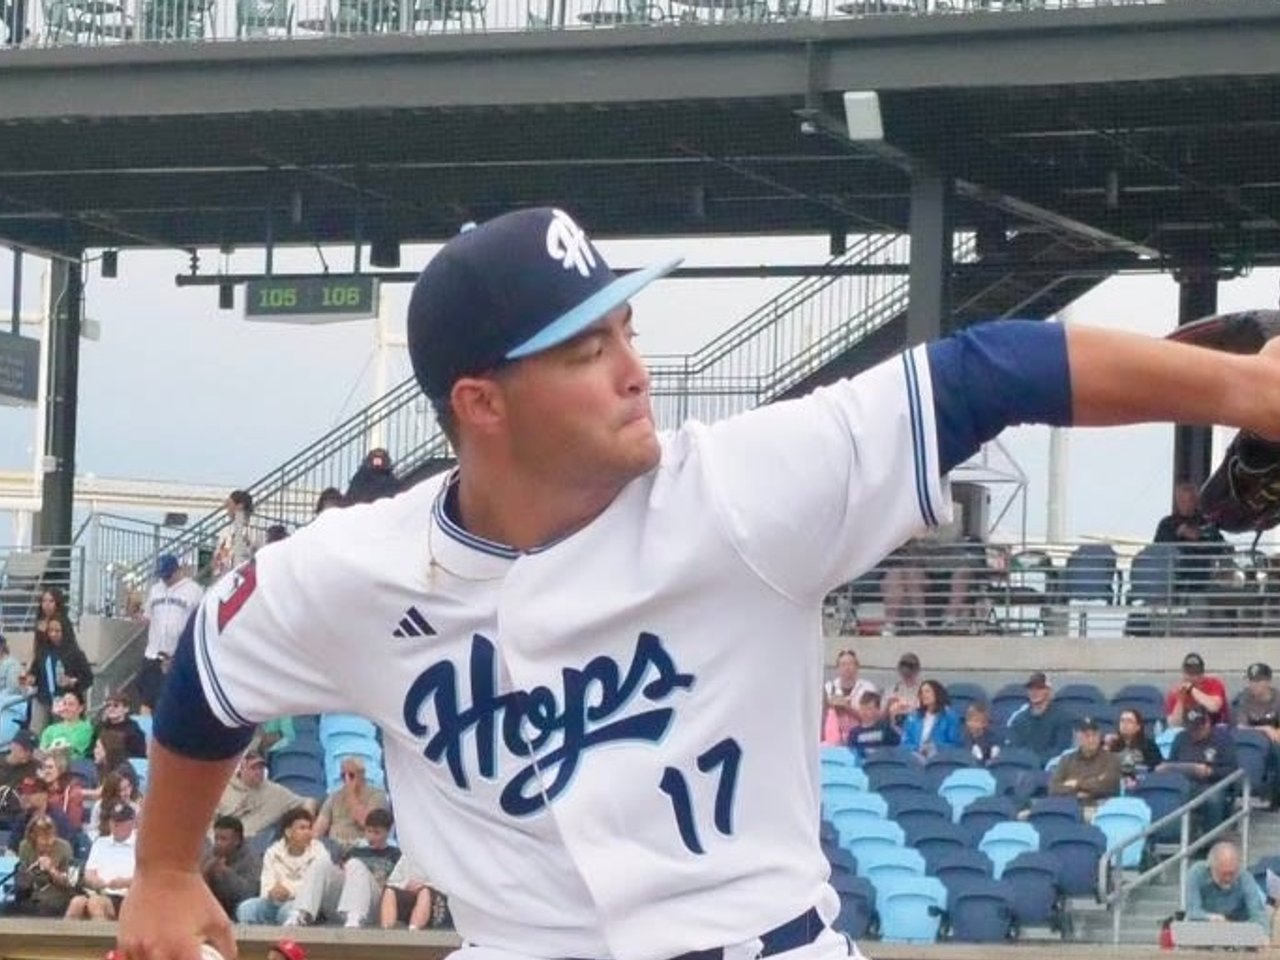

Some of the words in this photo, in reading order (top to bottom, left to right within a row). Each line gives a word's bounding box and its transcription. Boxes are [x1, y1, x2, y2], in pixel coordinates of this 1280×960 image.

[260, 288, 297, 307] 105
[322, 287, 360, 306] 106
[403, 631, 695, 817] Hops
[659, 736, 743, 856] 17
